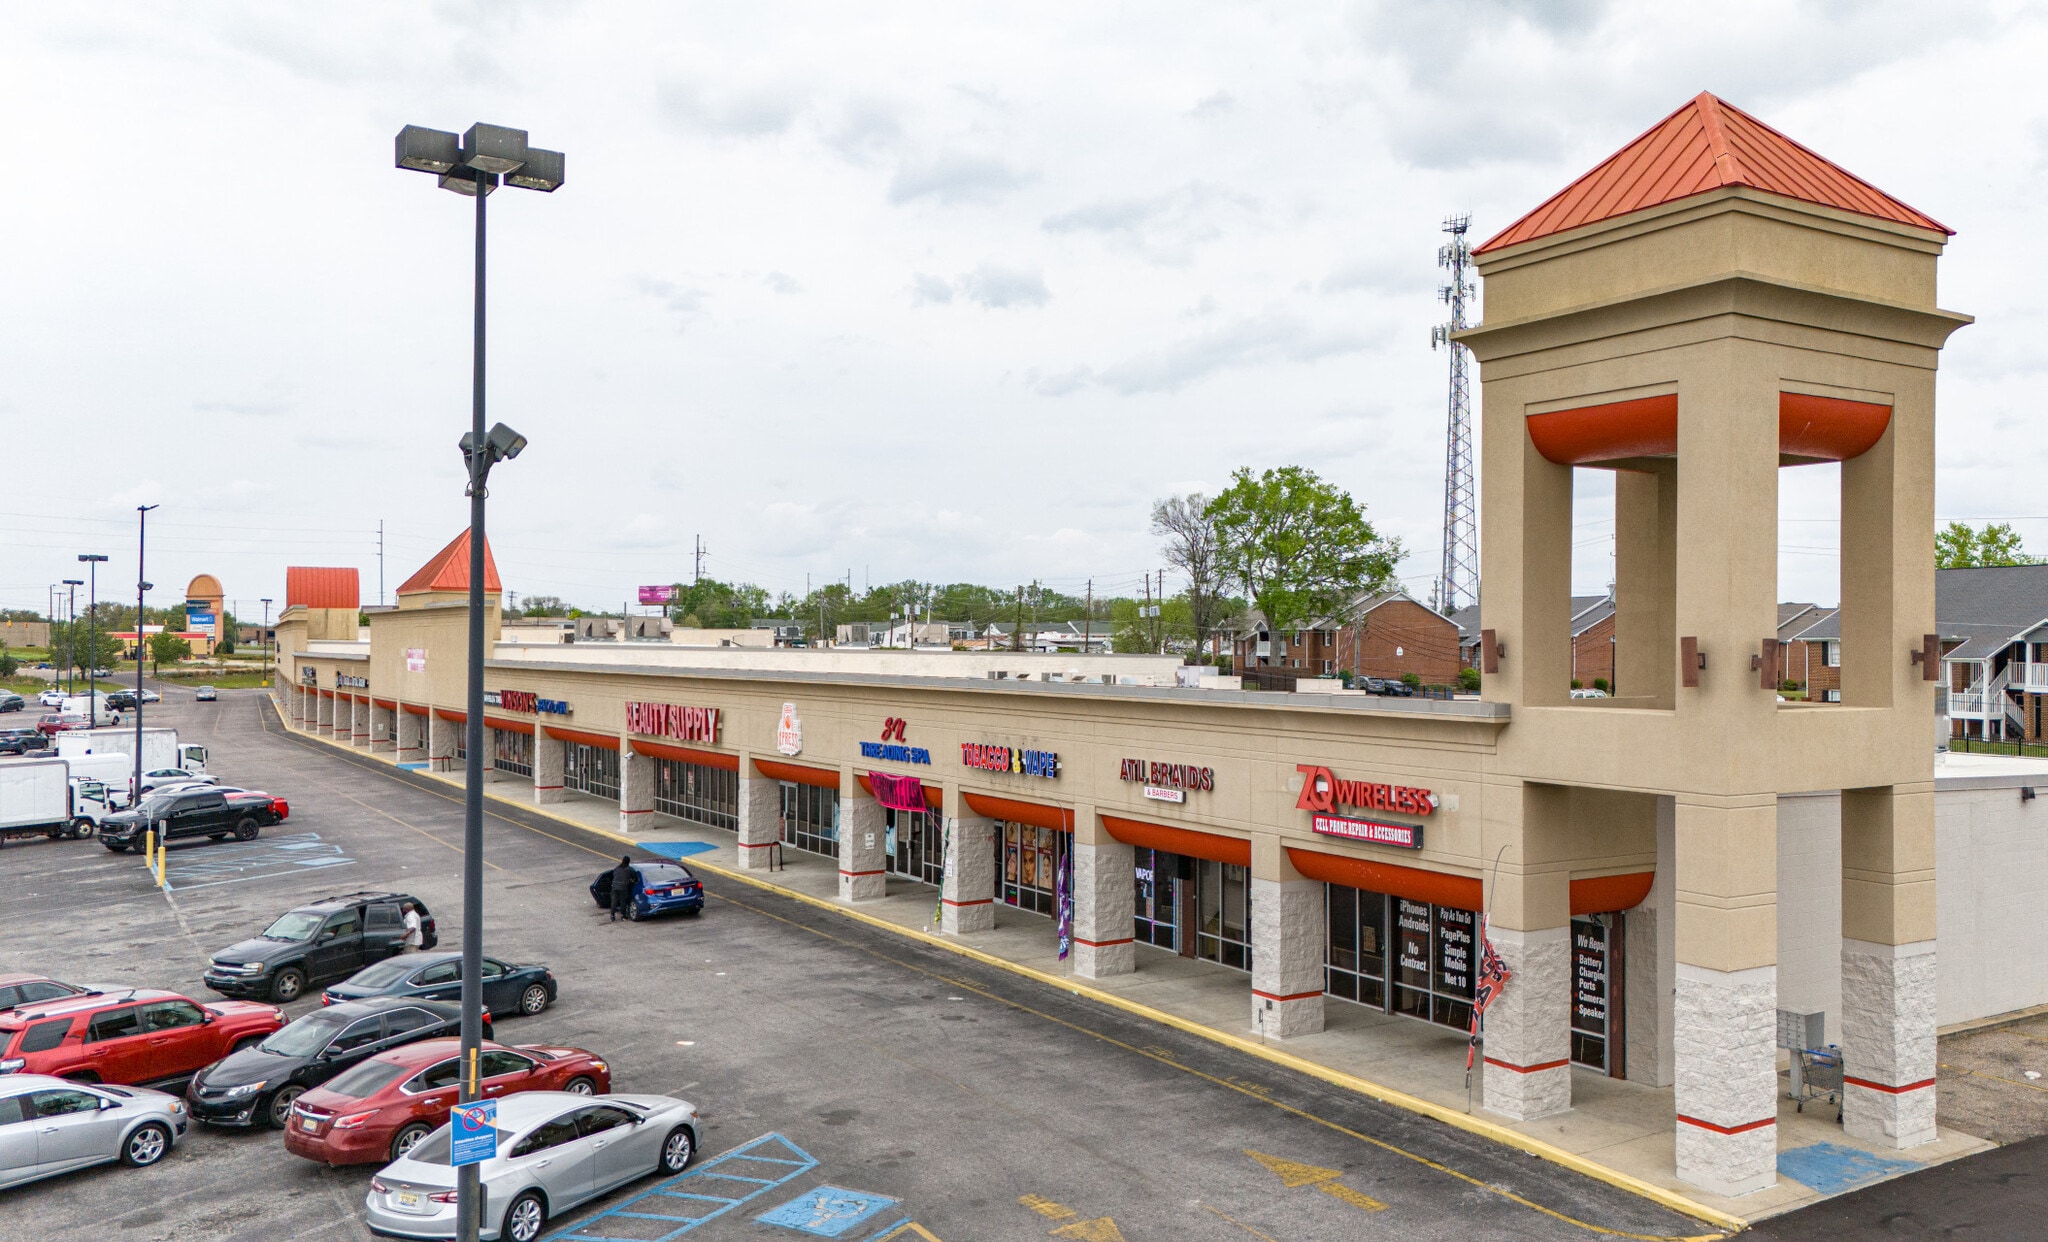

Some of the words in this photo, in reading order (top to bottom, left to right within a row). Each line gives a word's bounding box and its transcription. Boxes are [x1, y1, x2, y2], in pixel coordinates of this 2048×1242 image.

[625, 702, 669, 736] BEAUTY
[669, 705, 719, 744] SUPPLY
[859, 742, 910, 763] THREADING
[911, 748, 931, 765] SPA
[961, 743, 1010, 772] TOBACCO
[1012, 748, 1022, 774] &
[1025, 749, 1056, 778] VAPE
[1151, 761, 1213, 792] BRAIDS
[1146, 788, 1151, 796] &
[1151, 788, 1179, 800] BARBERS
[1296, 764, 1337, 814] ZQ
[1334, 779, 1433, 816] WIRELESS
[1315, 818, 1329, 832] CELL
[1329, 819, 1347, 835] PHONE
[1348, 820, 1368, 838] REPAIR
[1369, 824, 1373, 838] &
[1374, 825, 1411, 843] ACCESSORIES
[1400, 901, 1427, 917] iPhones
[1440, 908, 1449, 922] Pay
[1448, 909, 1456, 921] As
[1456, 911, 1465, 923] You
[1465, 914, 1471, 924] Go
[1399, 915, 1429, 932] Androids
[1441, 927, 1470, 944] PagePlus
[1577, 934, 1588, 948] We
[1408, 942, 1418, 955] No
[1444, 944, 1466, 959] Simple
[1400, 954, 1426, 971] Contract
[1444, 957, 1466, 972] Mobile
[1579, 954, 1602, 971] Battery
[1444, 973, 1457, 986] Net
[1458, 975, 1466, 988] 10
[1579, 978, 1596, 991] Ports
